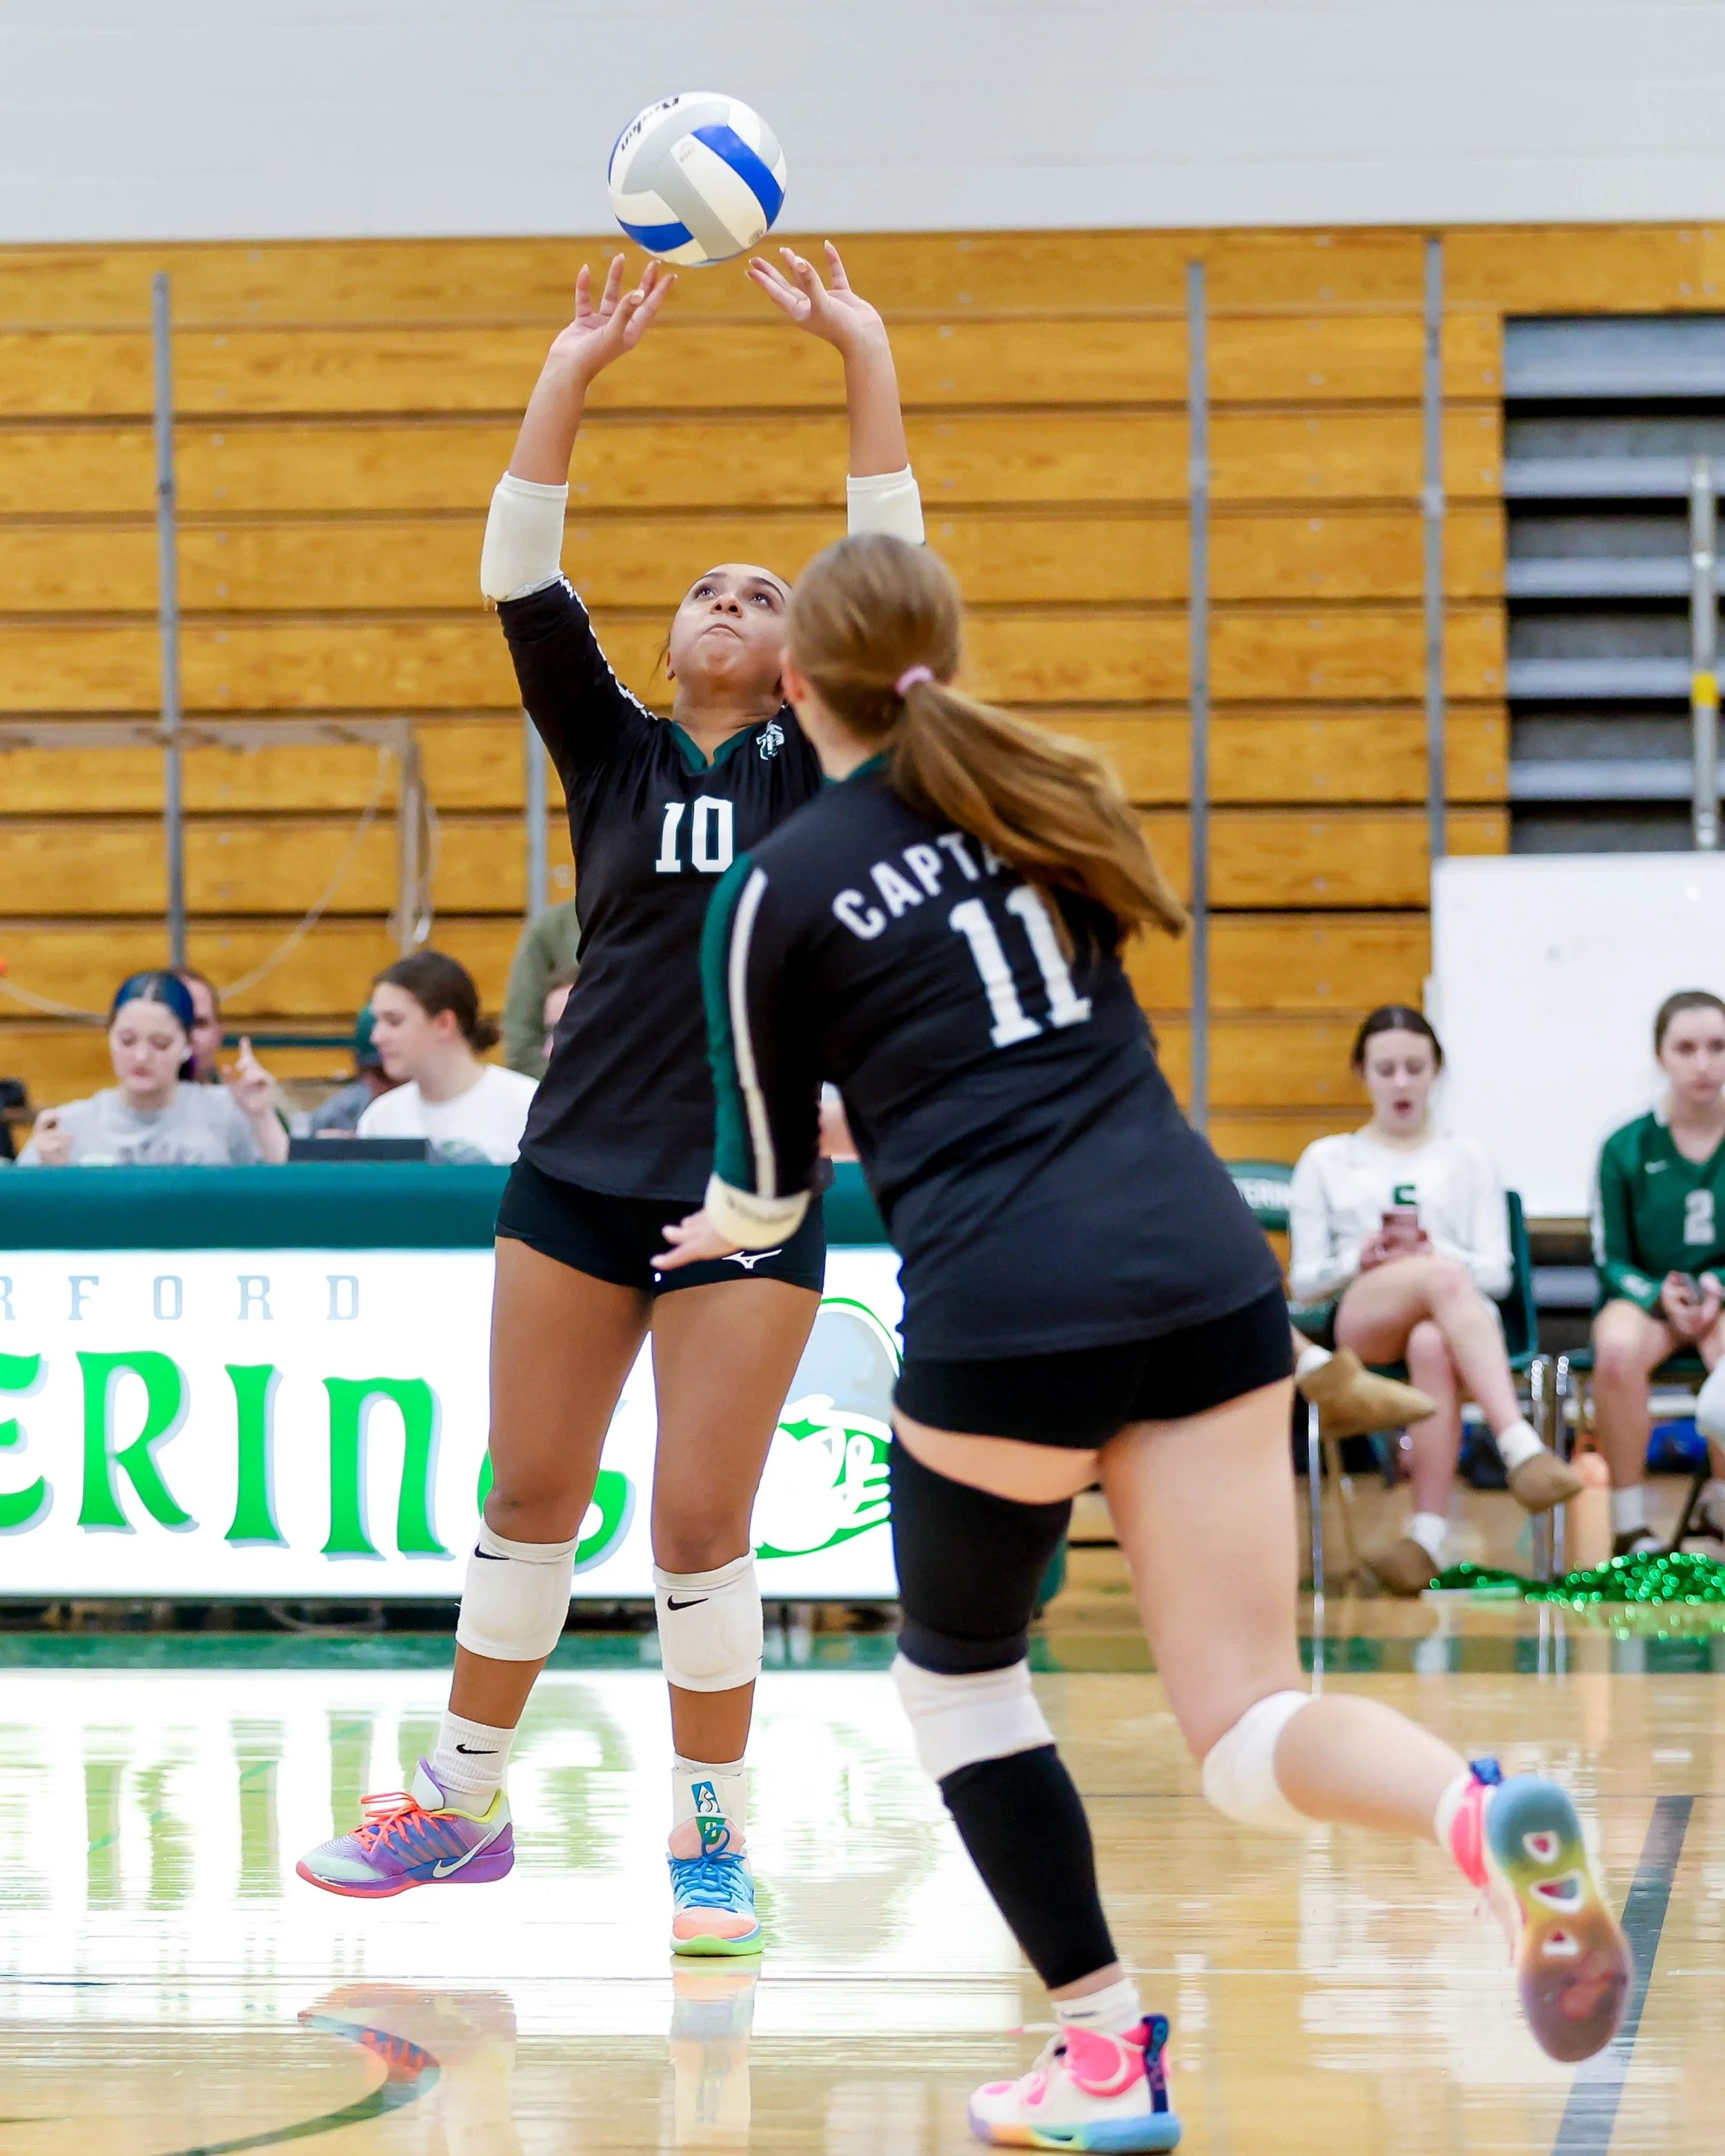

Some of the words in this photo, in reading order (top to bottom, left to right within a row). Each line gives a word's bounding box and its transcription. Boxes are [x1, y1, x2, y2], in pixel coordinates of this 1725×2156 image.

[656, 795, 733, 873] 10
[949, 884, 1092, 1049] 11
[1684, 1188, 1715, 1246] 2
